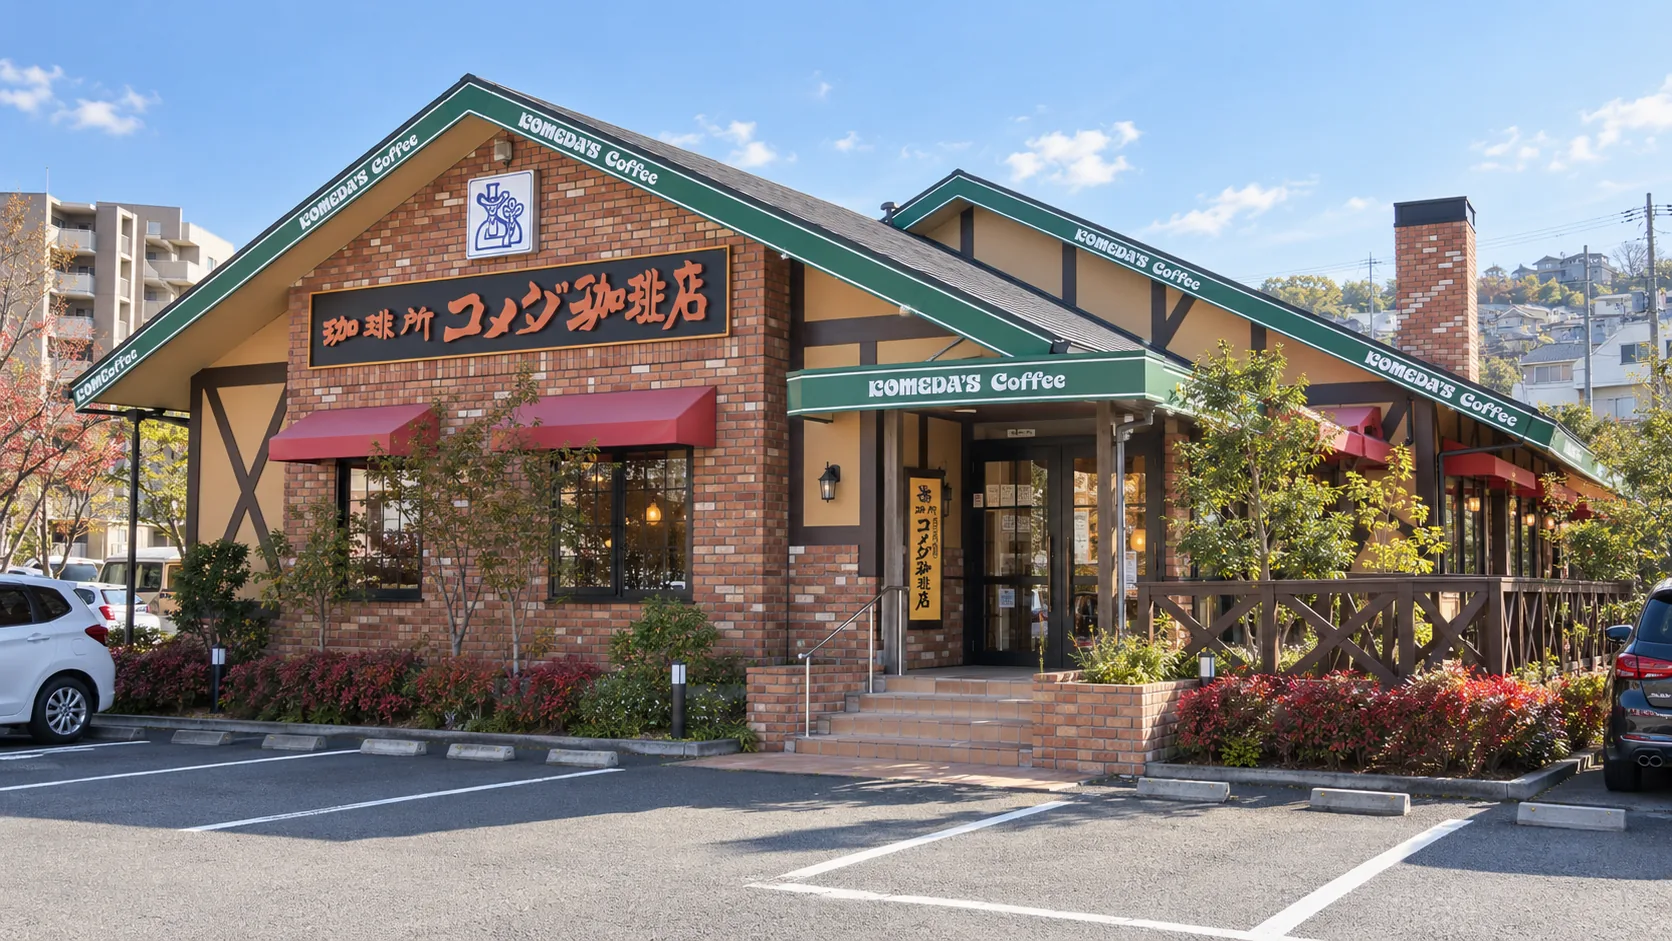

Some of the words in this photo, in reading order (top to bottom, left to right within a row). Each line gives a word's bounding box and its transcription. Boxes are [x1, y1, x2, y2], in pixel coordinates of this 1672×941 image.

[299, 169, 369, 230] KOMEDA'S
[371, 134, 418, 174] Coffee
[518, 112, 602, 159] KOMEDA'S
[605, 151, 658, 185] Coffee
[1074, 228, 1149, 268] KOMEDA'S
[1152, 261, 1200, 290] Coffee
[868, 374, 981, 398] KOMEDA'S
[991, 371, 1066, 392] Coffee
[1364, 350, 1456, 399] KOMEDA'S
[1459, 392, 1518, 427] Coffee
